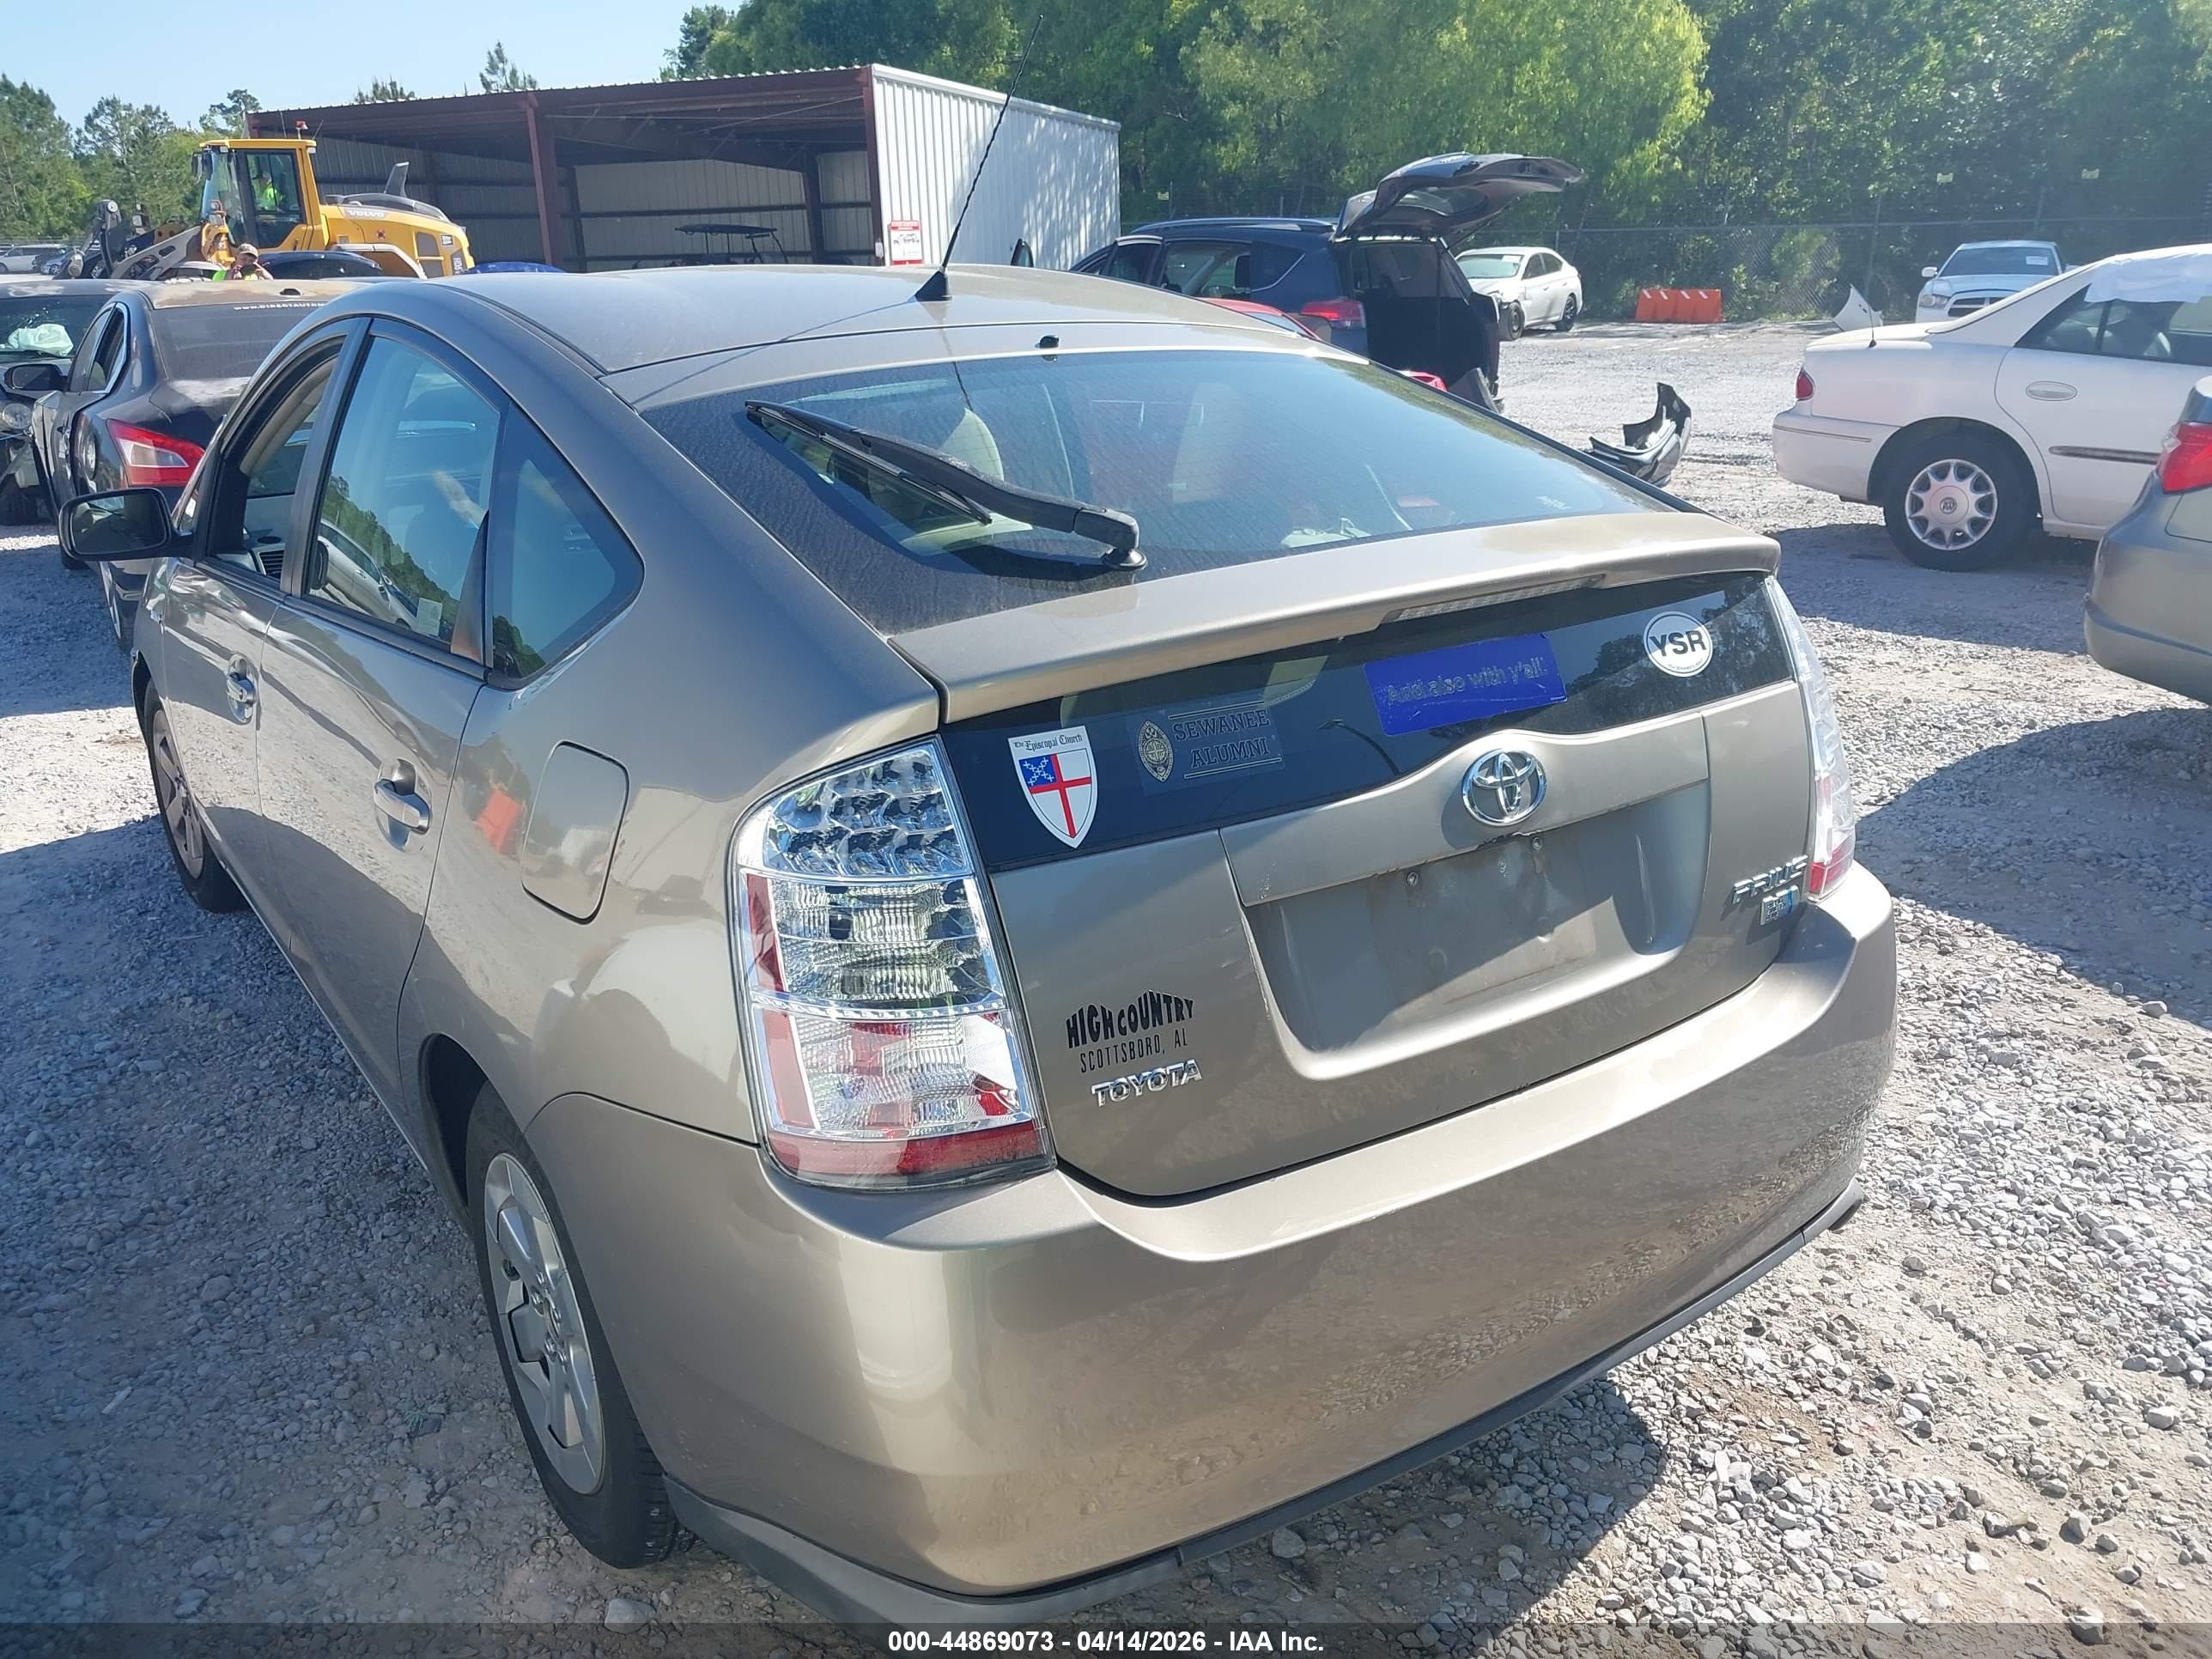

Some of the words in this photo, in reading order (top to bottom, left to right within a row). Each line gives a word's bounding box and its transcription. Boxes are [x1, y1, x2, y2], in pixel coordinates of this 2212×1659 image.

[1649, 629, 1707, 657] YSR
[1388, 679, 1426, 704] And
[1427, 674, 1466, 697] also
[1467, 666, 1509, 688] with
[1023, 737, 1059, 752] Episcopal
[1059, 733, 1084, 745] Church
[1172, 709, 1271, 742] SEWANEE
[1190, 738, 1270, 769] ALUMNI
[1732, 854, 1808, 904] PRIUS
[1066, 1004, 1115, 1049] HIGH
[1117, 990, 1194, 1036] COUNTRY
[1079, 1034, 1166, 1073] SCOTTSBORO,
[1174, 1028, 1188, 1049] AL
[1091, 1059, 1203, 1107] TOYOTA
